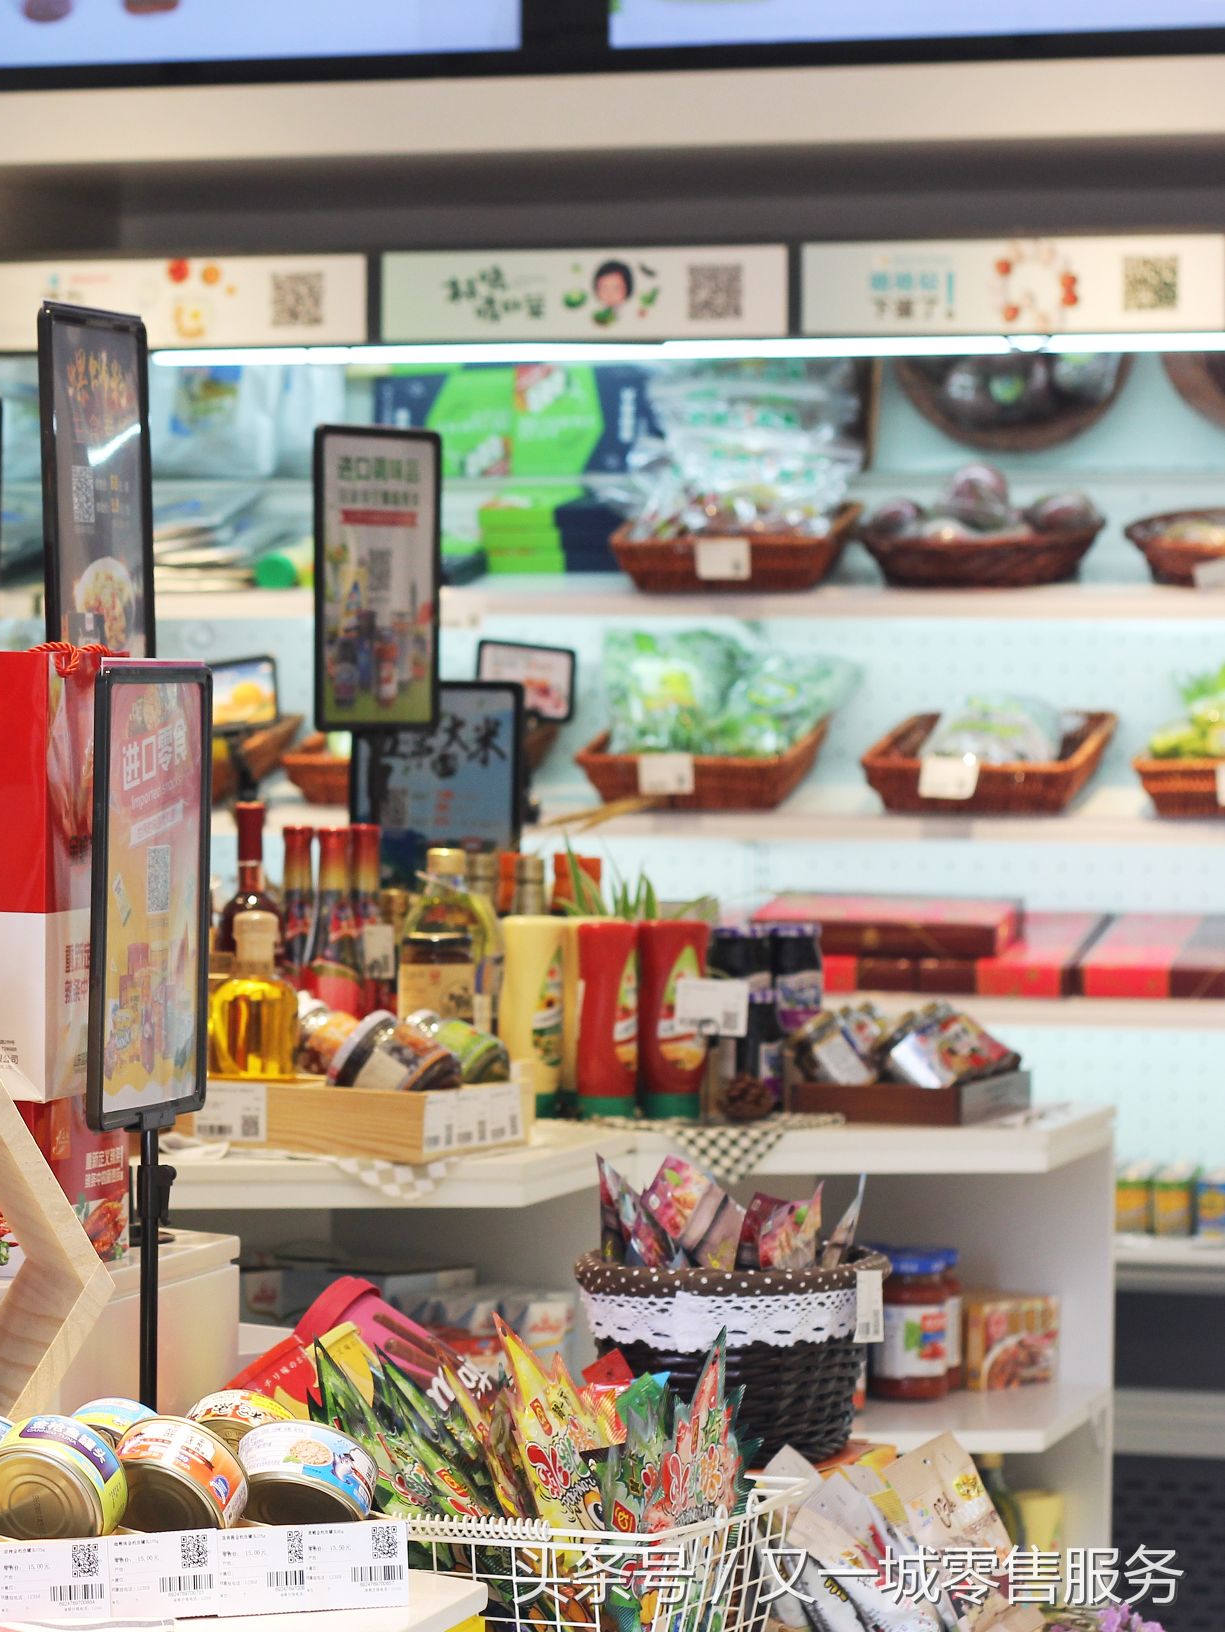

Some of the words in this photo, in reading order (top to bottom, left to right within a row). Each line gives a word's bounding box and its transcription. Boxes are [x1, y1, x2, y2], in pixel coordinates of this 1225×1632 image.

[31, 1419, 107, 1464] 金枪鱼罐头
